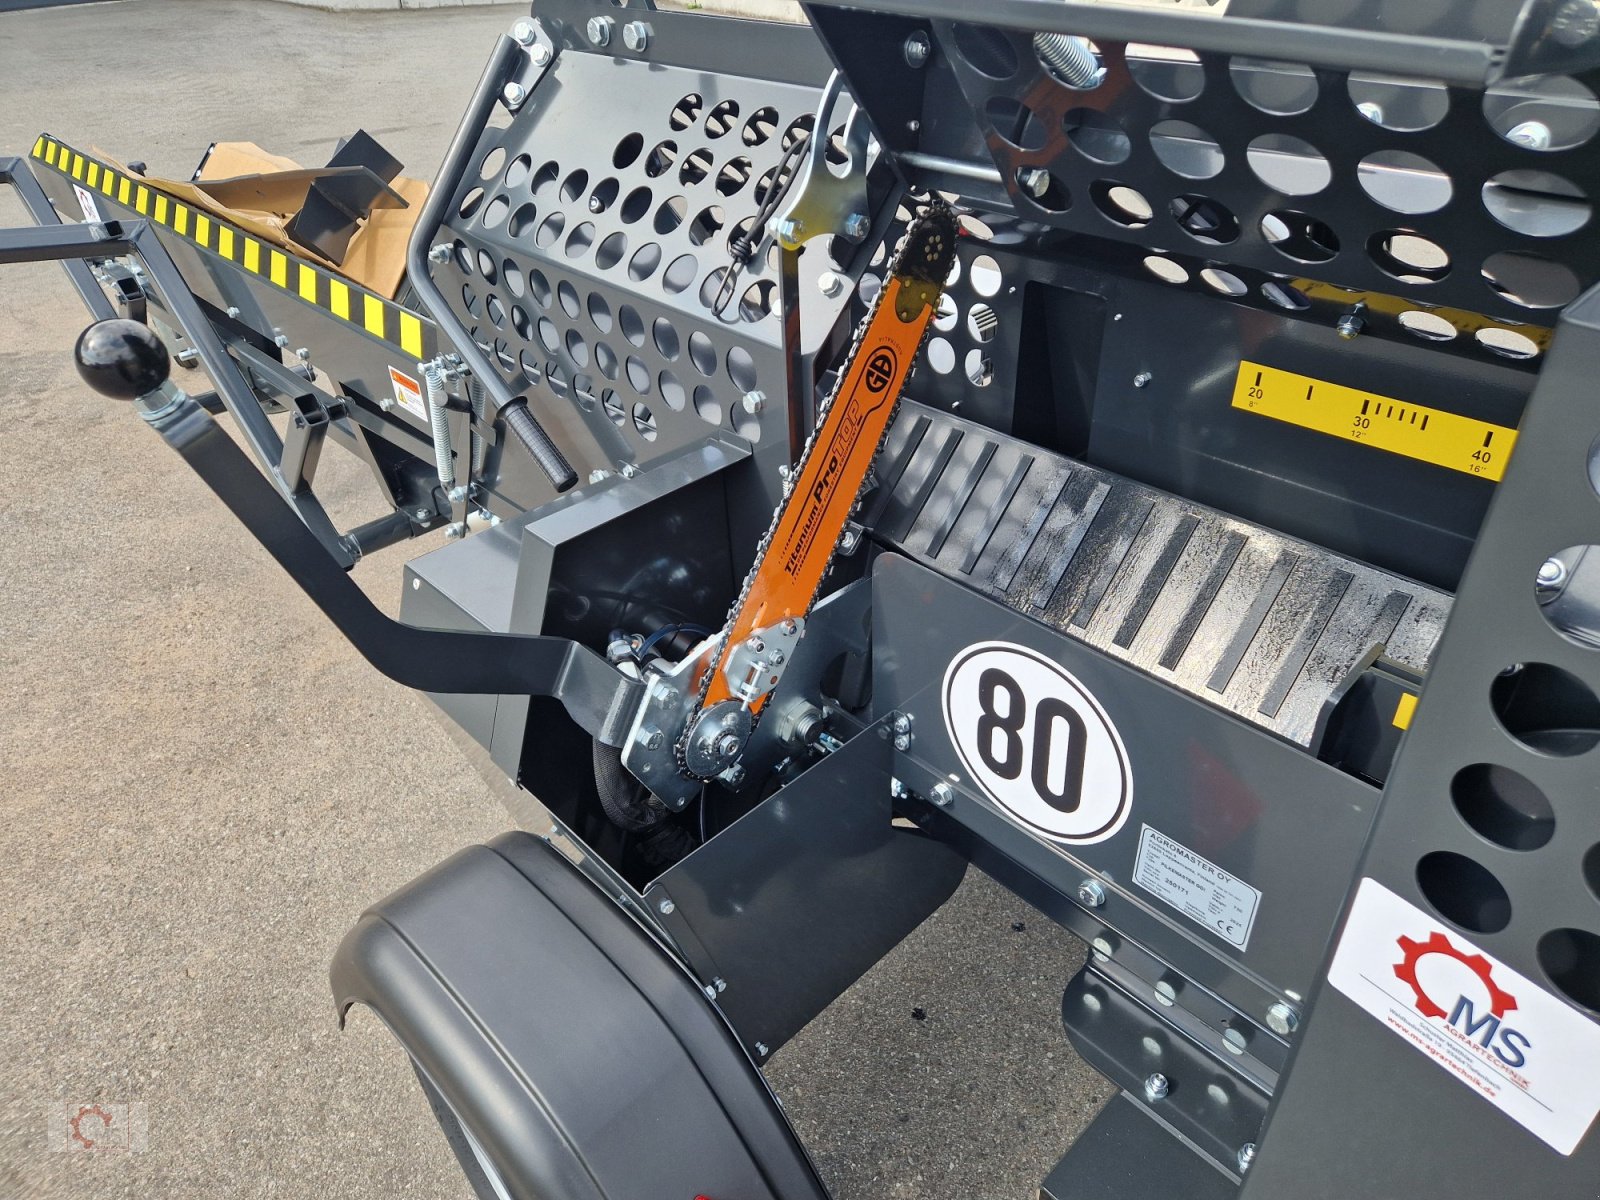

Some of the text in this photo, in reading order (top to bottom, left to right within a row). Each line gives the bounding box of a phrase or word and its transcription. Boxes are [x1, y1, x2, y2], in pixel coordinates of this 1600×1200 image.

[1248, 387, 1263, 399] 20
[1353, 416, 1370, 429] 30
[1472, 450, 1491, 464] 40
[785, 505, 818, 573] Titanium
[977, 668, 1087, 813] 80
[1150, 833, 1214, 874] AGROMASTER
[1217, 872, 1232, 883] OY
[1164, 877, 1188, 895] 250171
[1388, 1016, 1495, 1097] www.ms-agrartechnik.de
[1444, 1024, 1530, 1087] AGRARTECHNIK
[1448, 994, 1532, 1068] MS
